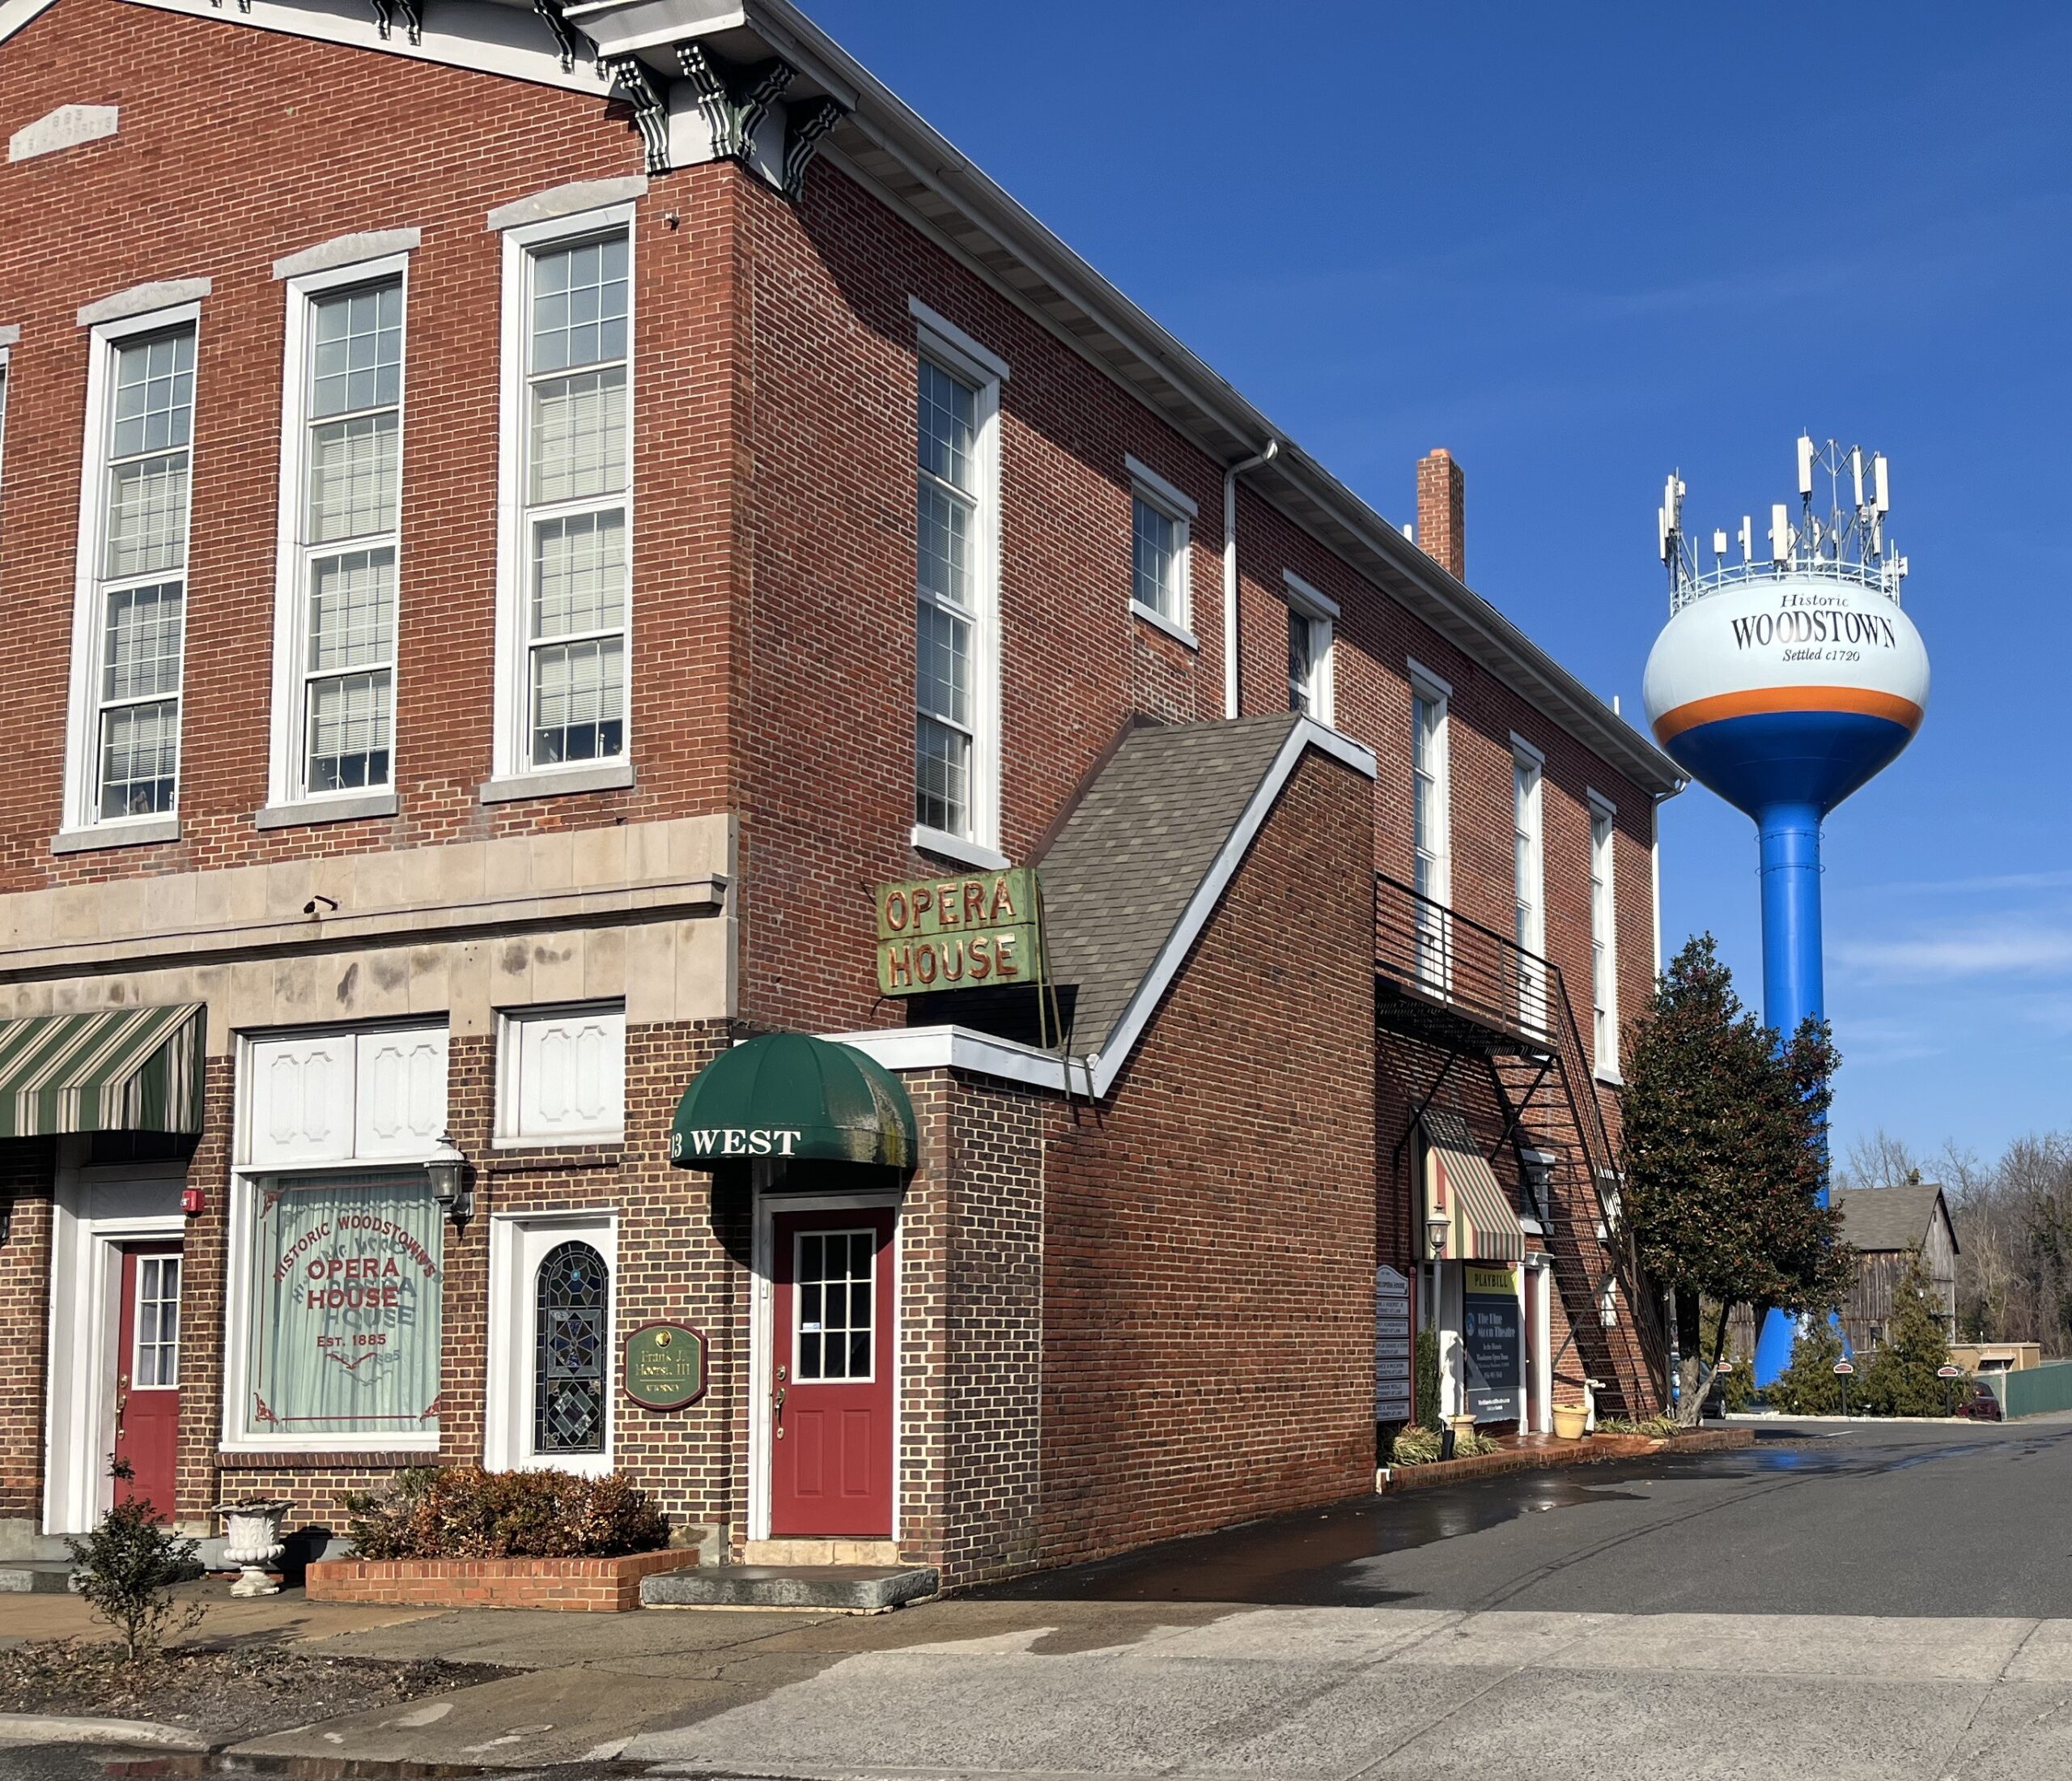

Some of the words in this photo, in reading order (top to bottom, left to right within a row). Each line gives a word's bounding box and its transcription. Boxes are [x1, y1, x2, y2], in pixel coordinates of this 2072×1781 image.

[1780, 593, 1849, 607] Historic
[1730, 610, 1896, 650] WOODSTOWN
[1782, 648, 1823, 661] Settled
[1826, 650, 1860, 661] c1720
[885, 877, 1017, 931] OPERA
[889, 933, 1018, 988] HOUSE
[671, 1133, 682, 1158] 13
[690, 1129, 801, 1155] WEST
[273, 1222, 331, 1282] HISTORIC
[308, 1257, 401, 1280] OPERA
[1474, 1273, 1508, 1287] PLAYBILL
[308, 1286, 399, 1309] HOUSE
[353, 1333, 386, 1345] 1885
[641, 1350, 672, 1362] Frank
[676, 1350, 686, 1362] J.
[677, 1363, 690, 1375] III
